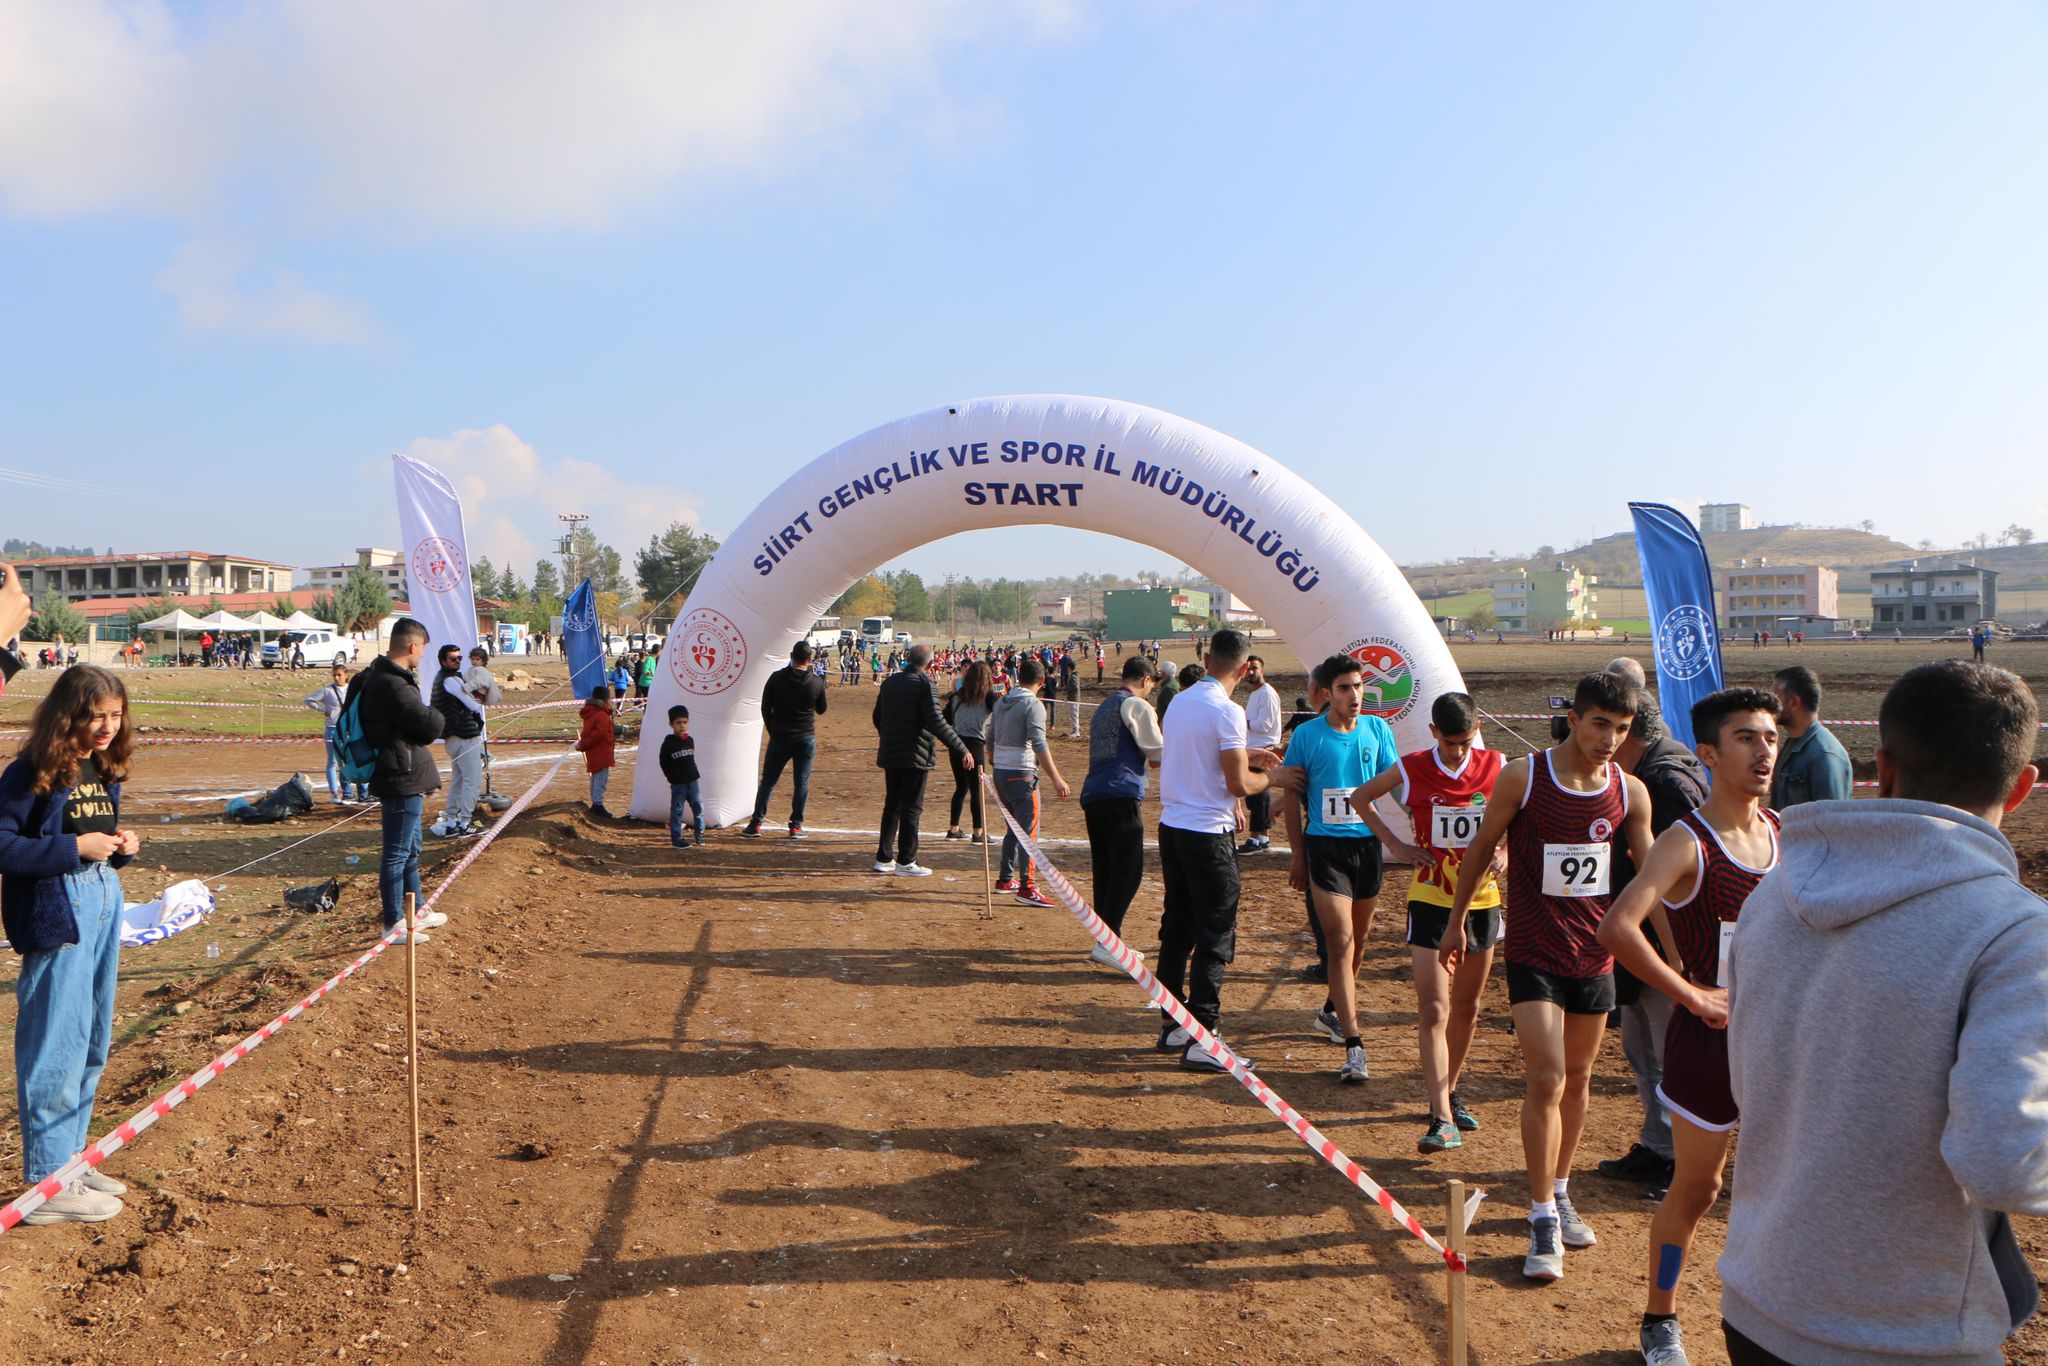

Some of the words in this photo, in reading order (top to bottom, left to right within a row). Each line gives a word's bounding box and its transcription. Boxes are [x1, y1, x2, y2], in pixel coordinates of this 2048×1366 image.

[963, 482, 1084, 506] START
[753, 510, 813, 576] SİİRT
[819, 450, 943, 517] GENÇLİK
[947, 442, 990, 467] VE
[1000, 441, 1086, 466] SPOR
[1093, 443, 1121, 476] İL
[1131, 460, 1320, 593] MÜDÜRLÜĞÜ
[1371, 636, 1418, 670] FEDERASYONU
[1395, 679, 1422, 723] FEDERATION
[1362, 746, 1372, 764] 6
[1560, 857, 1598, 885] 92
